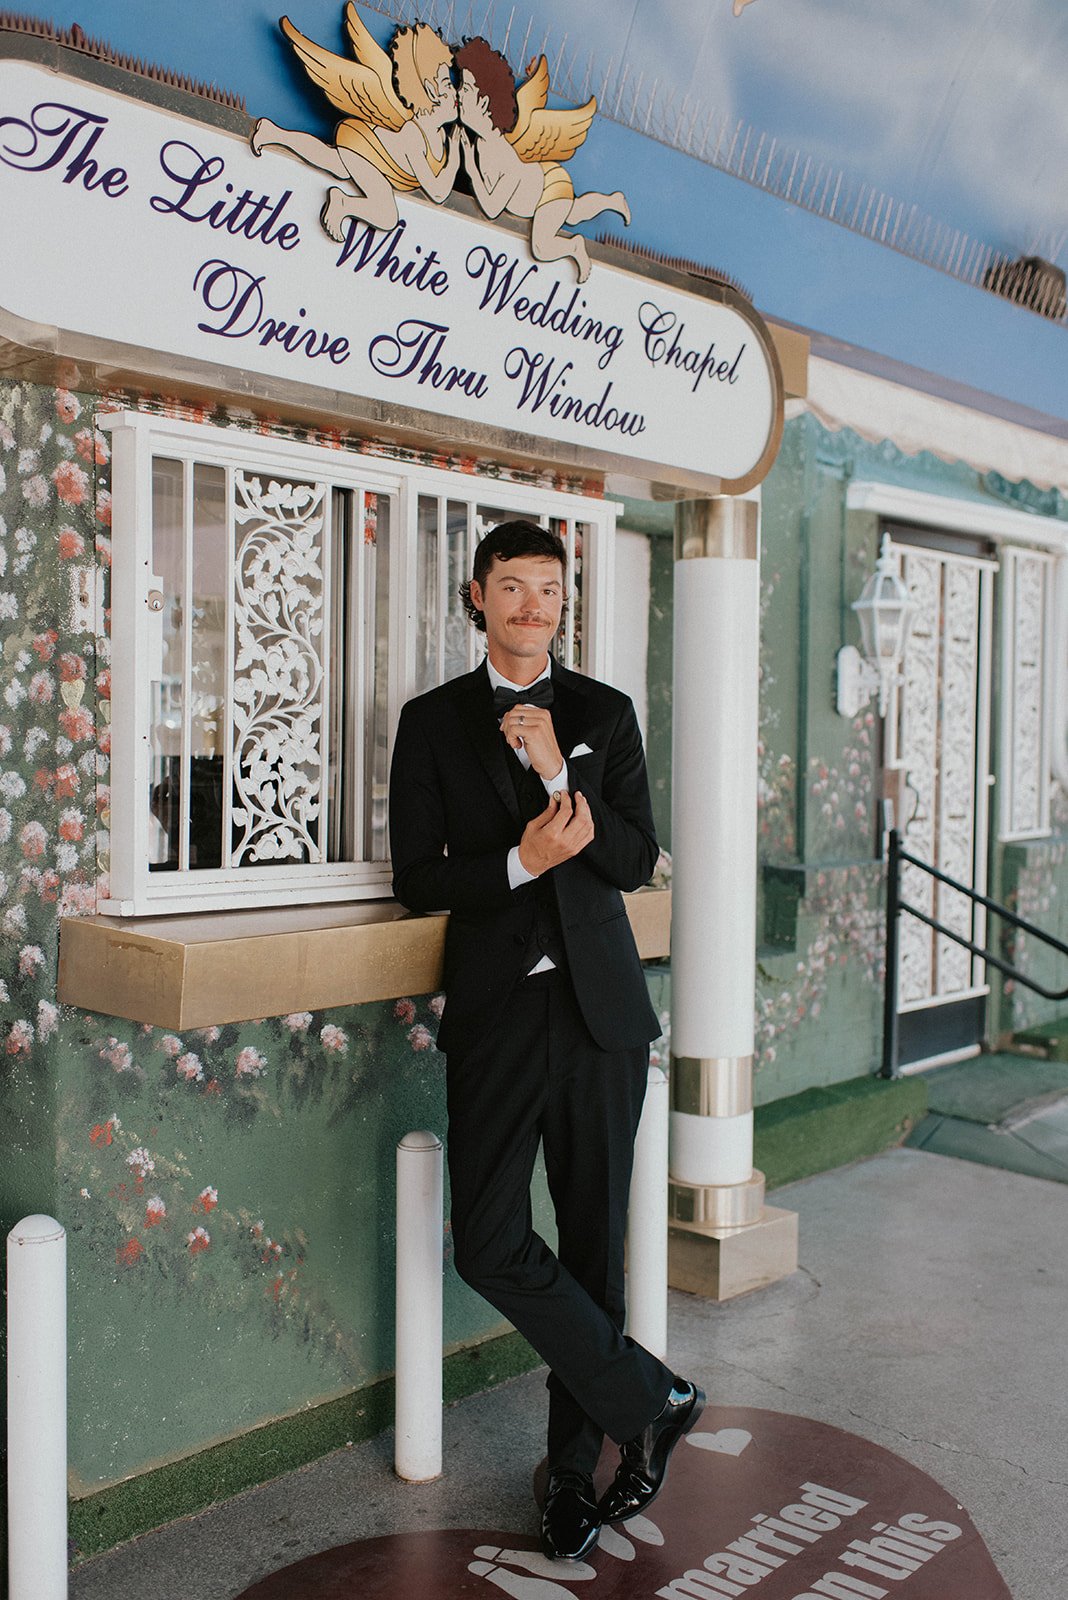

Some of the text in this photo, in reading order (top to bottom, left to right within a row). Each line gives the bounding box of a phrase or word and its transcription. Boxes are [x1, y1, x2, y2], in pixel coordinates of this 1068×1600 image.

[0, 102, 746, 392] The Little White Wedding Chapel
[193, 258, 646, 436] Drive Thru Window
[655, 1482, 869, 1600] married
[790, 1513, 962, 1600] n this
